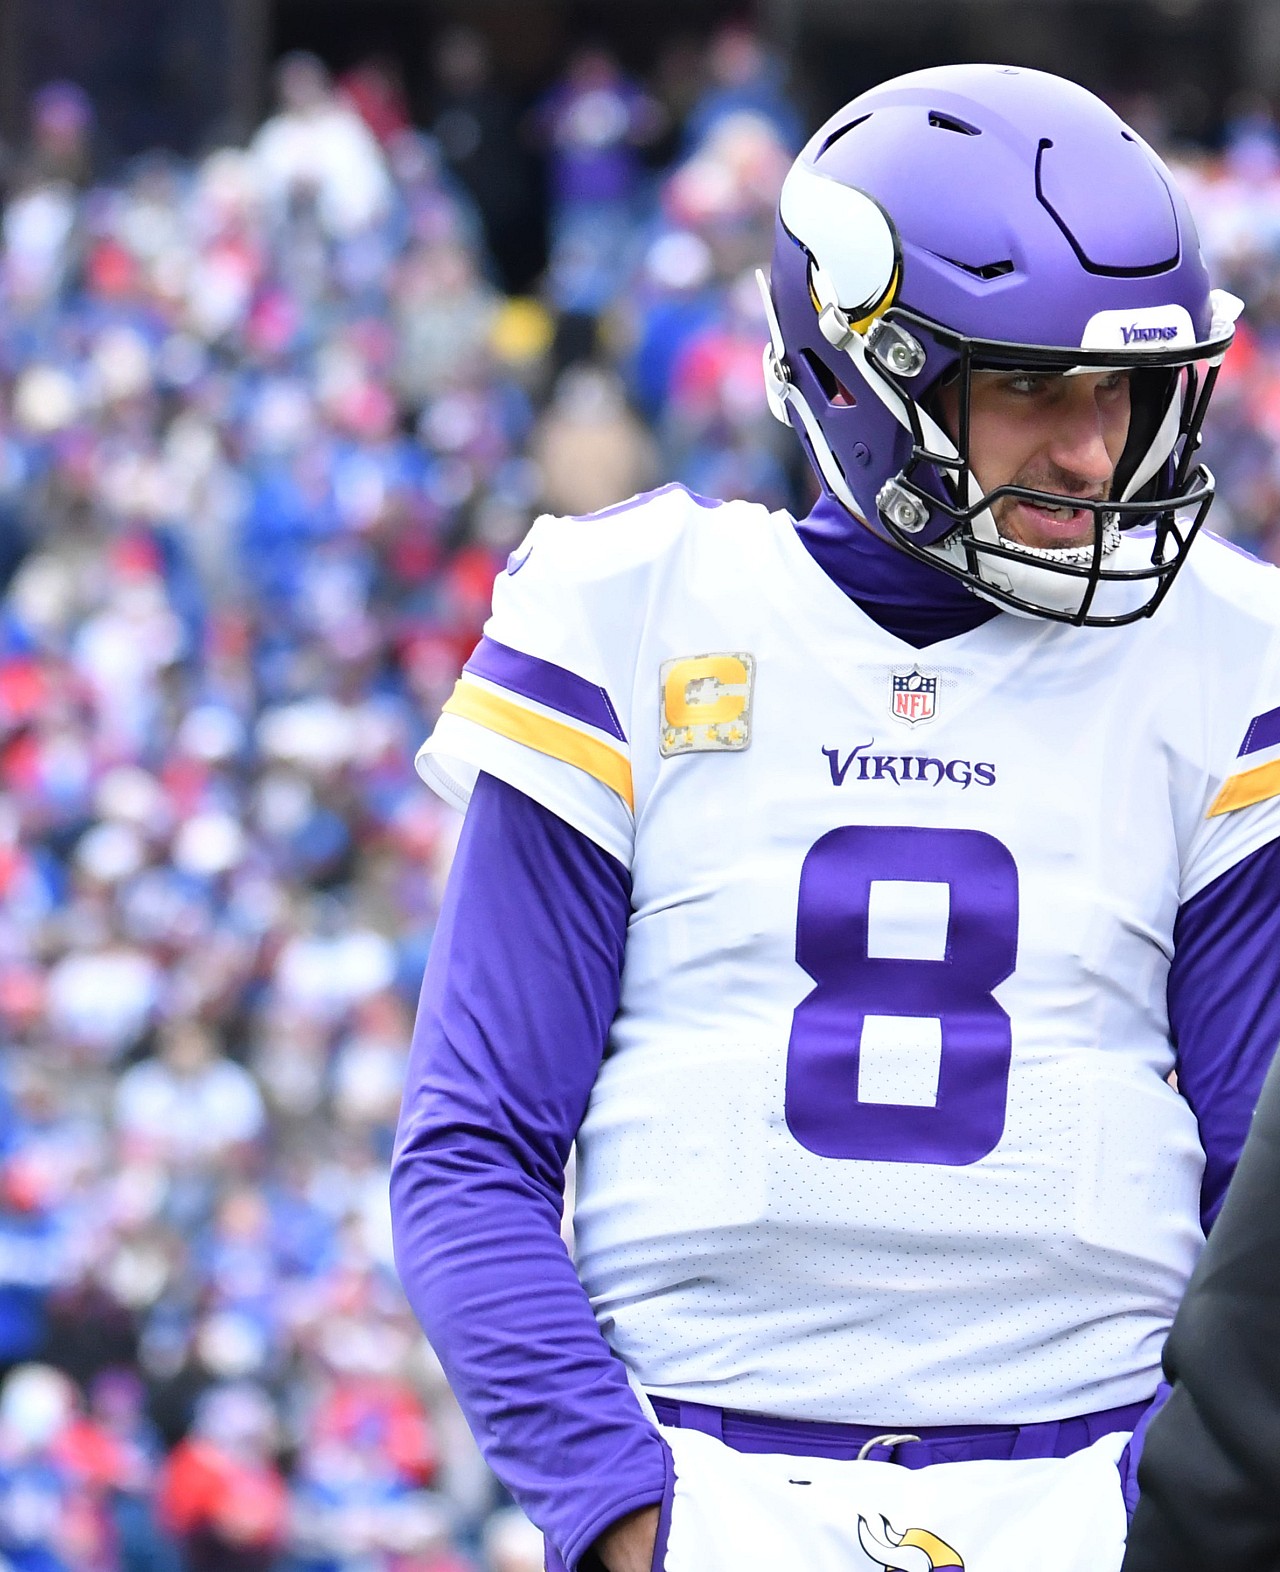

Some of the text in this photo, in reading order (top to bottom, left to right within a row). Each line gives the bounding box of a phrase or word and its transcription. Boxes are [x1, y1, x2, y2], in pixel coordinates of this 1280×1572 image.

[665, 656, 747, 728] C
[896, 693, 931, 719] NFL
[784, 825, 1019, 1166] 8
